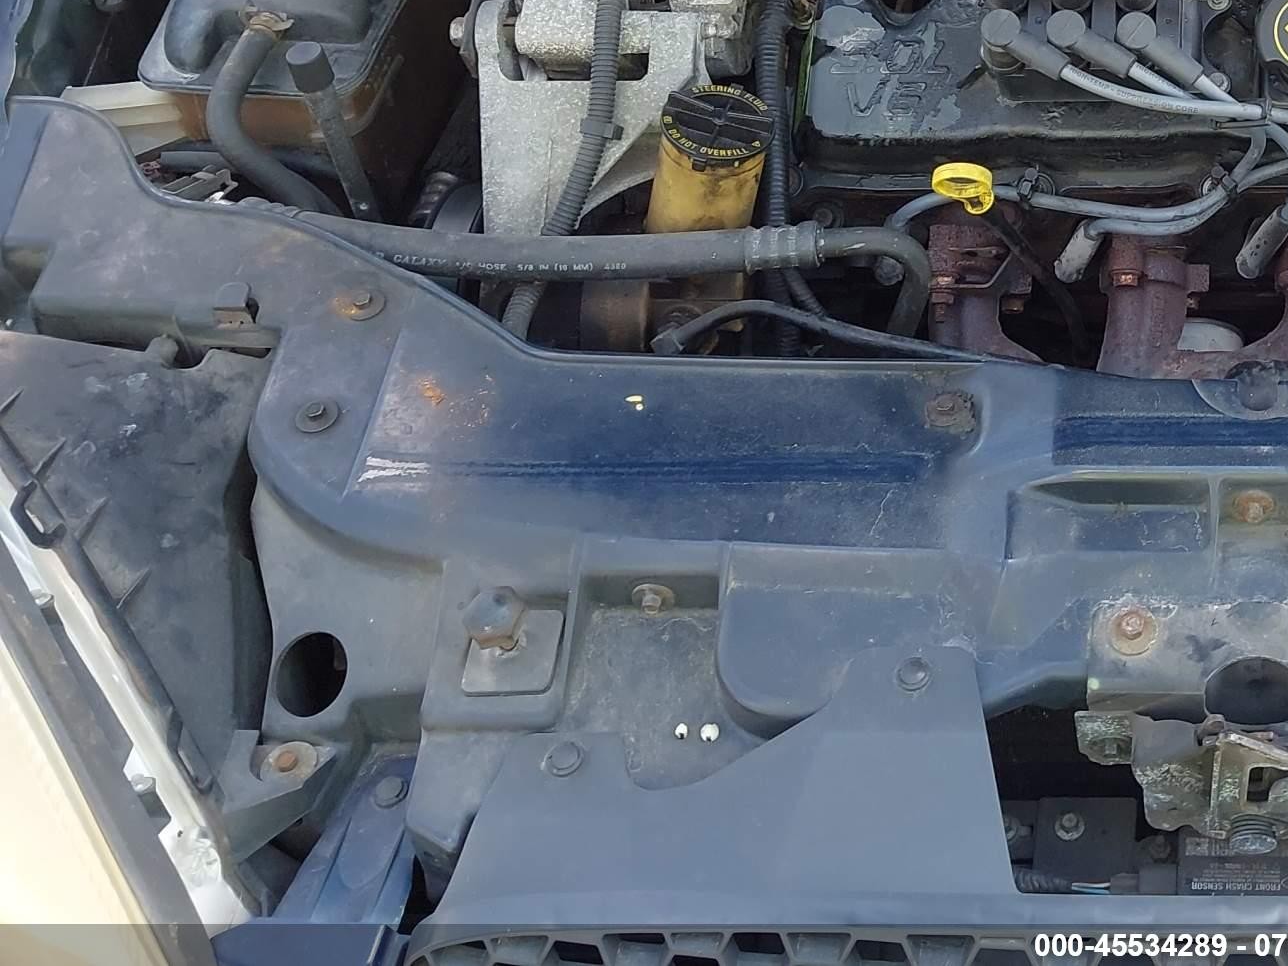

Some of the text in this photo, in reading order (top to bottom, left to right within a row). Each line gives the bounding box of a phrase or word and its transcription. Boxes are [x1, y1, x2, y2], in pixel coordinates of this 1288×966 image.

[829, 37, 950, 74] 3.0L
[692, 84, 769, 112] STEERING FLUID
[845, 81, 927, 117] V6
[1175, 105, 1199, 114] CORE
[668, 129, 750, 157] DO NOT OVERFILL
[517, 263, 533, 271] 5/8
[1191, 881, 1222, 891] SENSOR
[1225, 881, 1253, 891] CRASH
[1255, 882, 1281, 891] FRONT
